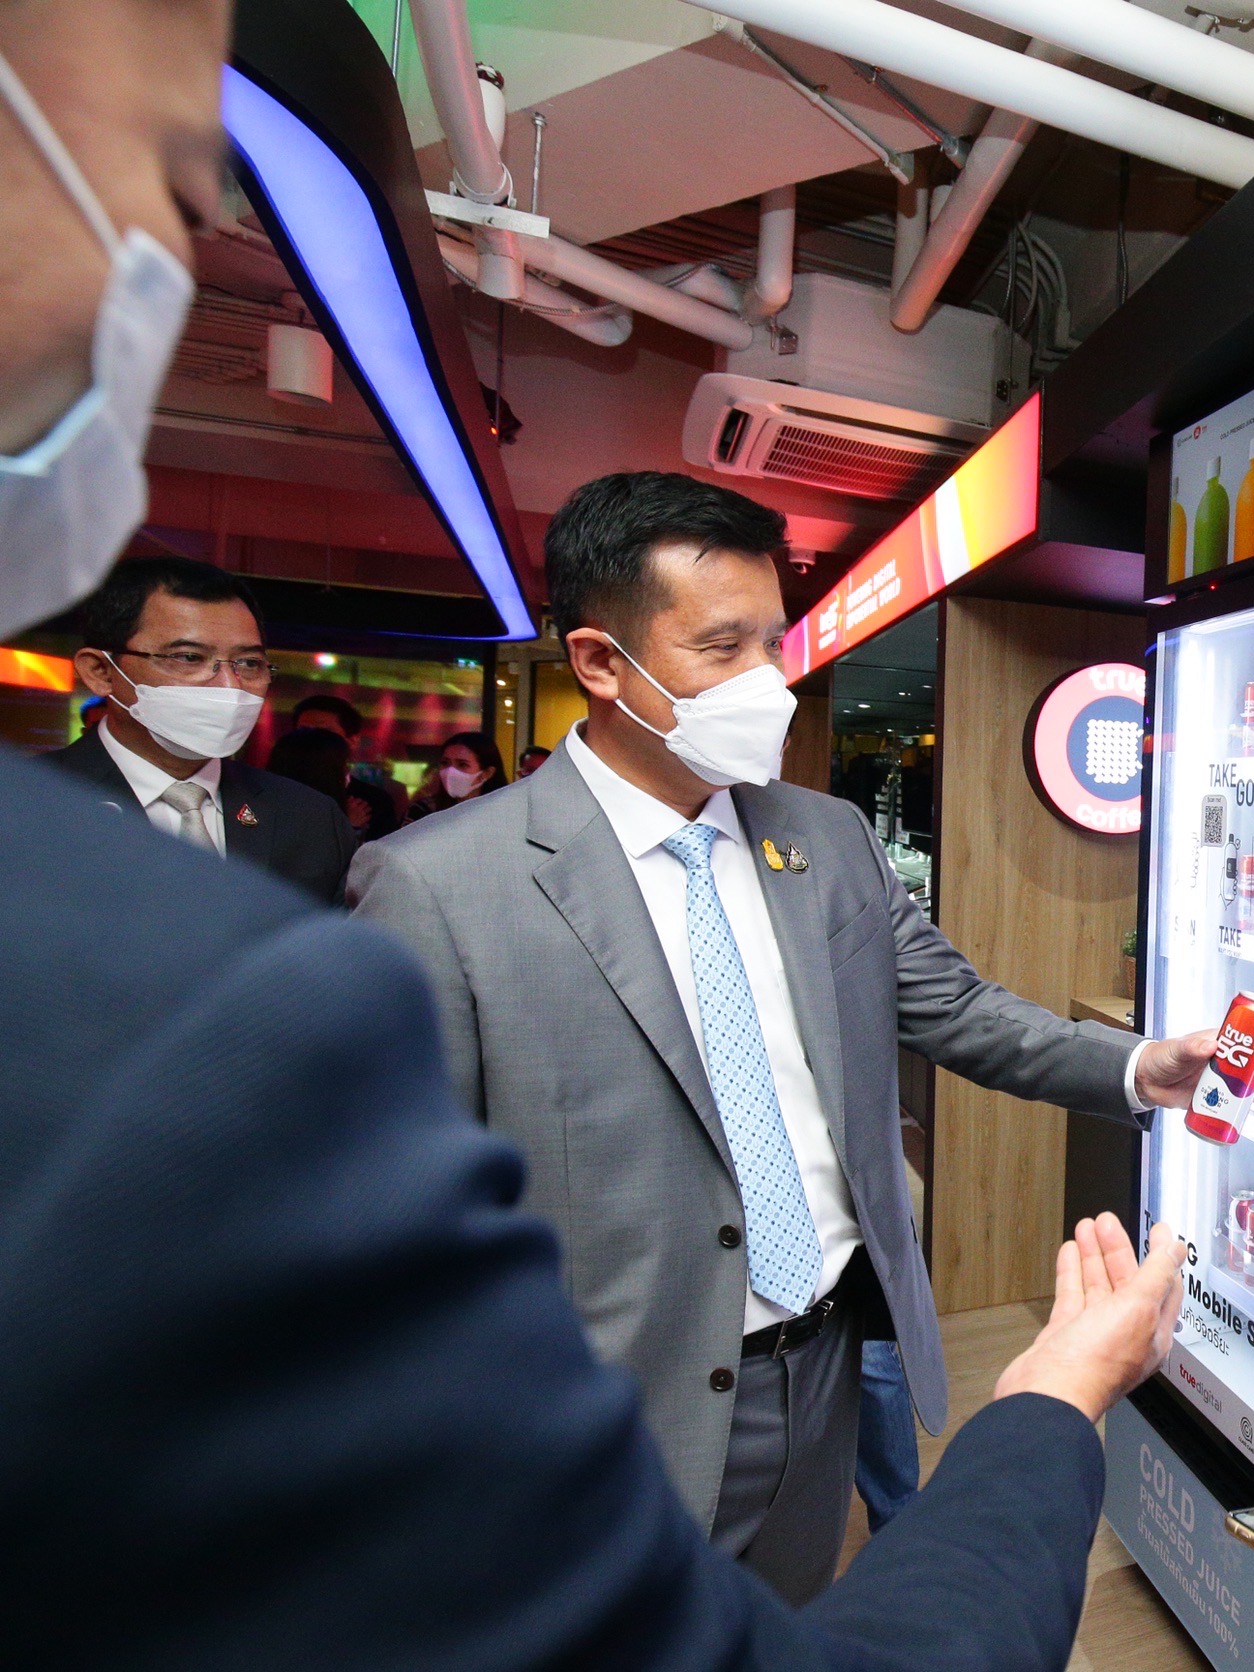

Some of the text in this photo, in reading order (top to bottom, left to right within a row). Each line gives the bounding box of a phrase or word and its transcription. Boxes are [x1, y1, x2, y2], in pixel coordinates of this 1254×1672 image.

[1209, 763, 1237, 788] TAKE
[1236, 778, 1254, 806] GO
[1219, 925, 1242, 948] TAKE
[1215, 1035, 1254, 1068] 5G
[1225, 1024, 1254, 1047] true
[1188, 1273, 1242, 1335] Mobile
[1179, 1363, 1222, 1413] truedigital
[1140, 1443, 1195, 1534] COLD
[1140, 1483, 1241, 1626] PRESSED JUICE
[1208, 1606, 1240, 1659] 100%
